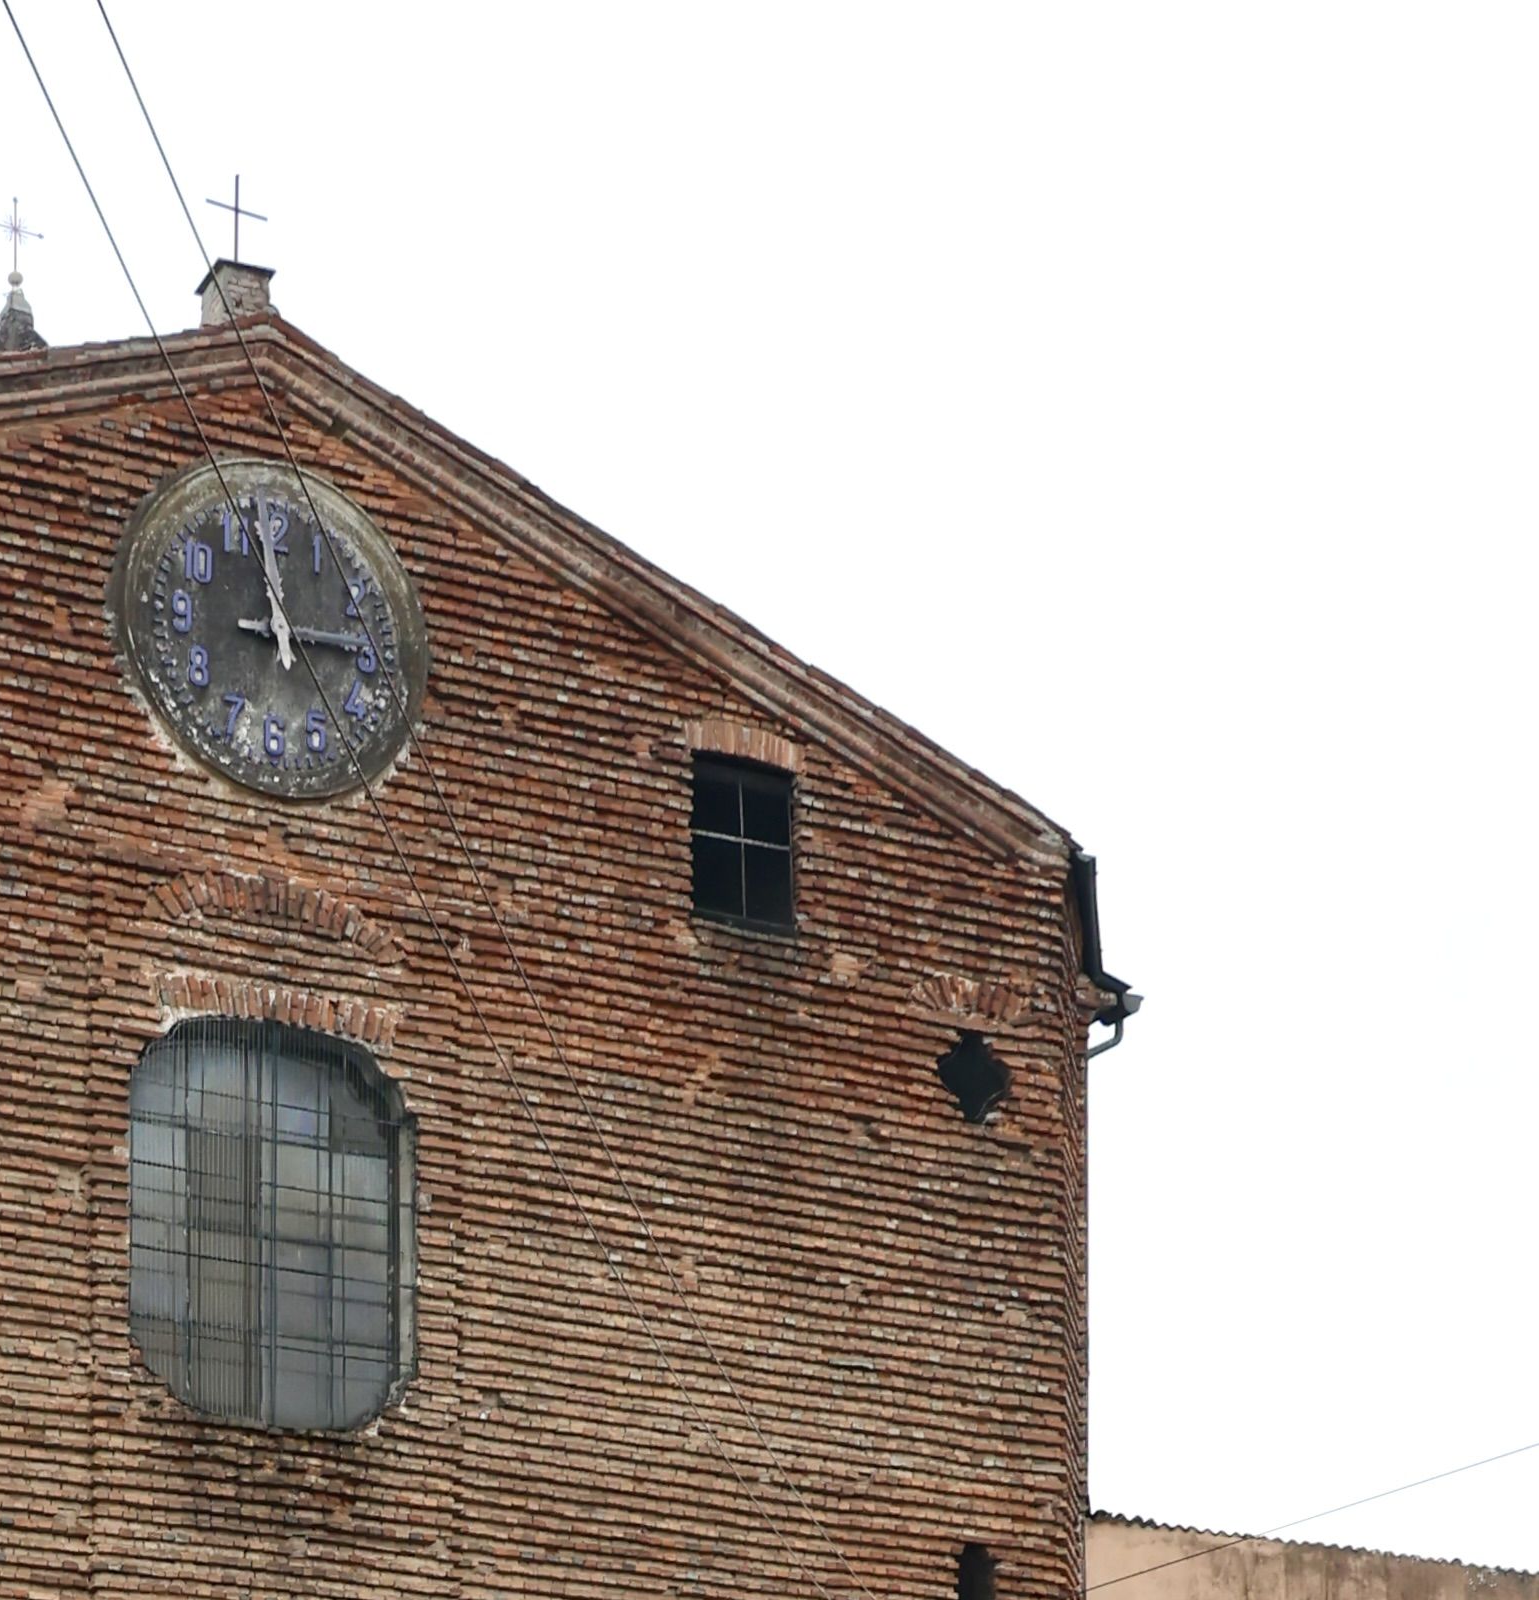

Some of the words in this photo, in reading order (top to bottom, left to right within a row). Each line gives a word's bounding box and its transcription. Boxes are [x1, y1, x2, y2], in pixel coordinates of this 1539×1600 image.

[223, 511, 249, 557] 11
[312, 535, 322, 575] 1
[183, 539, 213, 584] 10
[171, 590, 193, 633] 9
[345, 577, 366, 618] 2
[188, 644, 210, 687] 8
[223, 692, 246, 743] 7
[342, 679, 366, 720] 4
[263, 713, 285, 757] 6
[305, 709, 327, 753] 5
